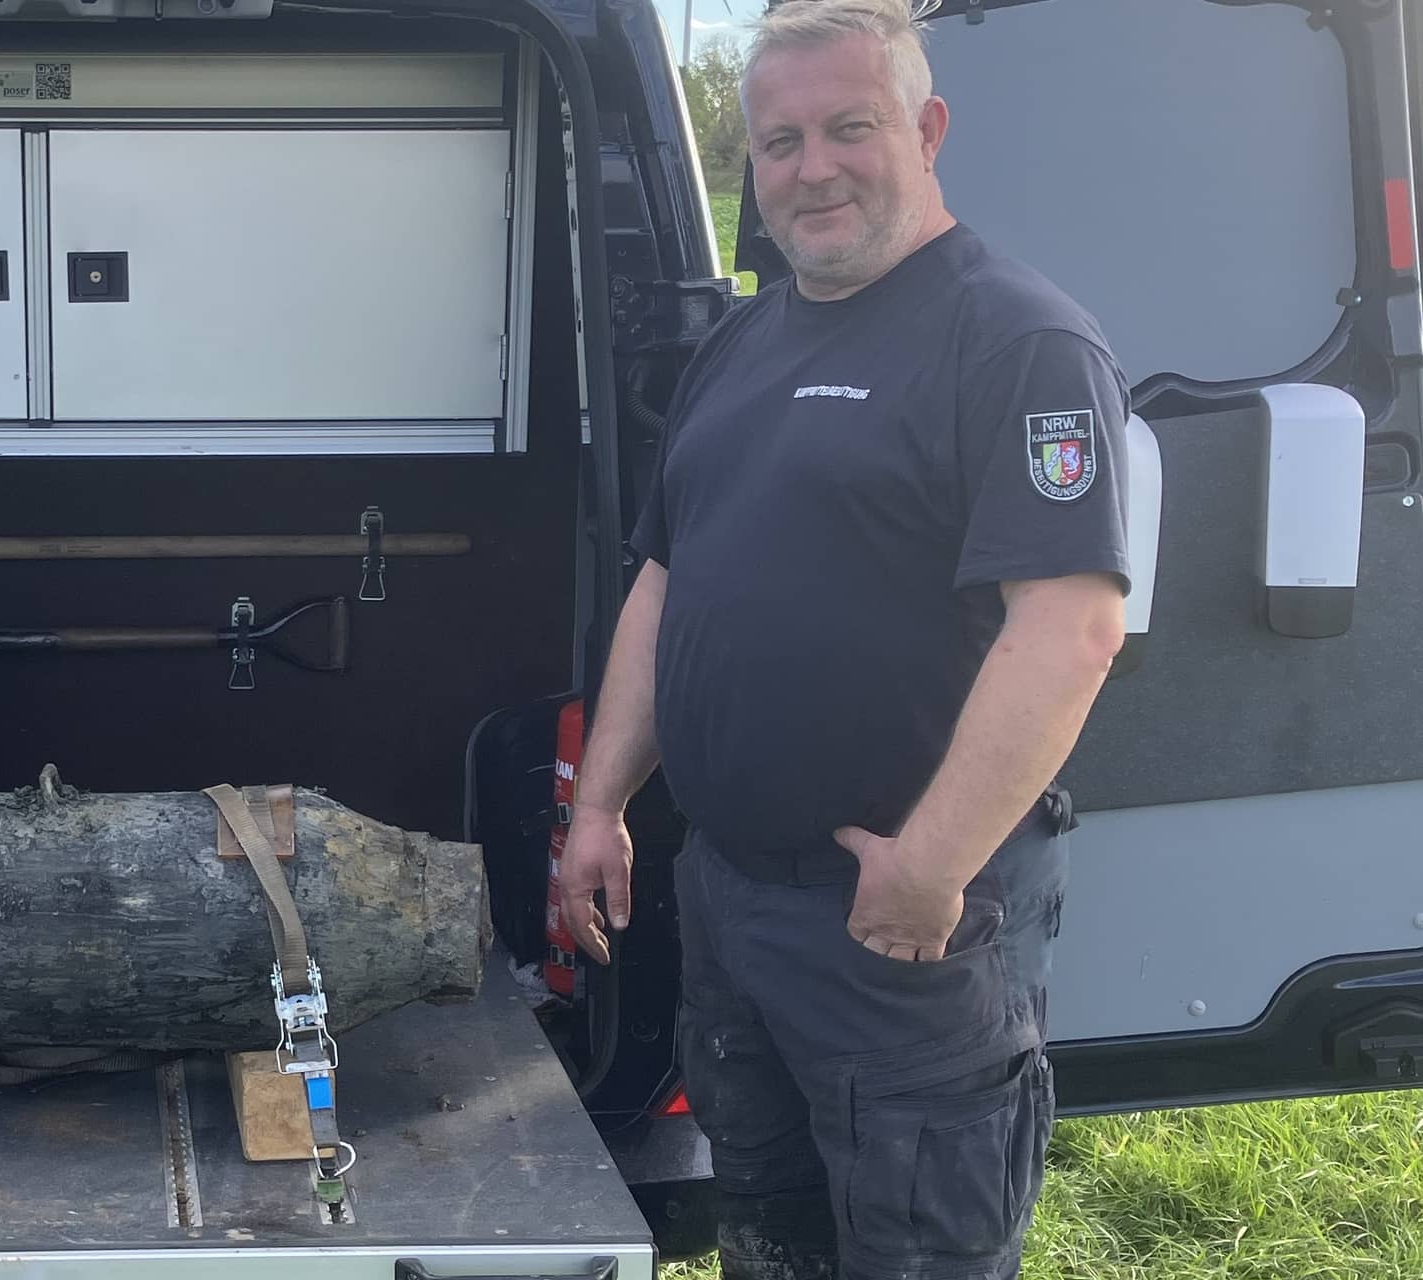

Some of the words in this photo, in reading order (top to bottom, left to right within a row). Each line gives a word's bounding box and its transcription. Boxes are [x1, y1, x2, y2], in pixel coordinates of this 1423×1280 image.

[3, 87, 31, 97] poser
[1042, 416, 1077, 432] NRW
[1032, 429, 1090, 443] KAMPFMITTEL-
